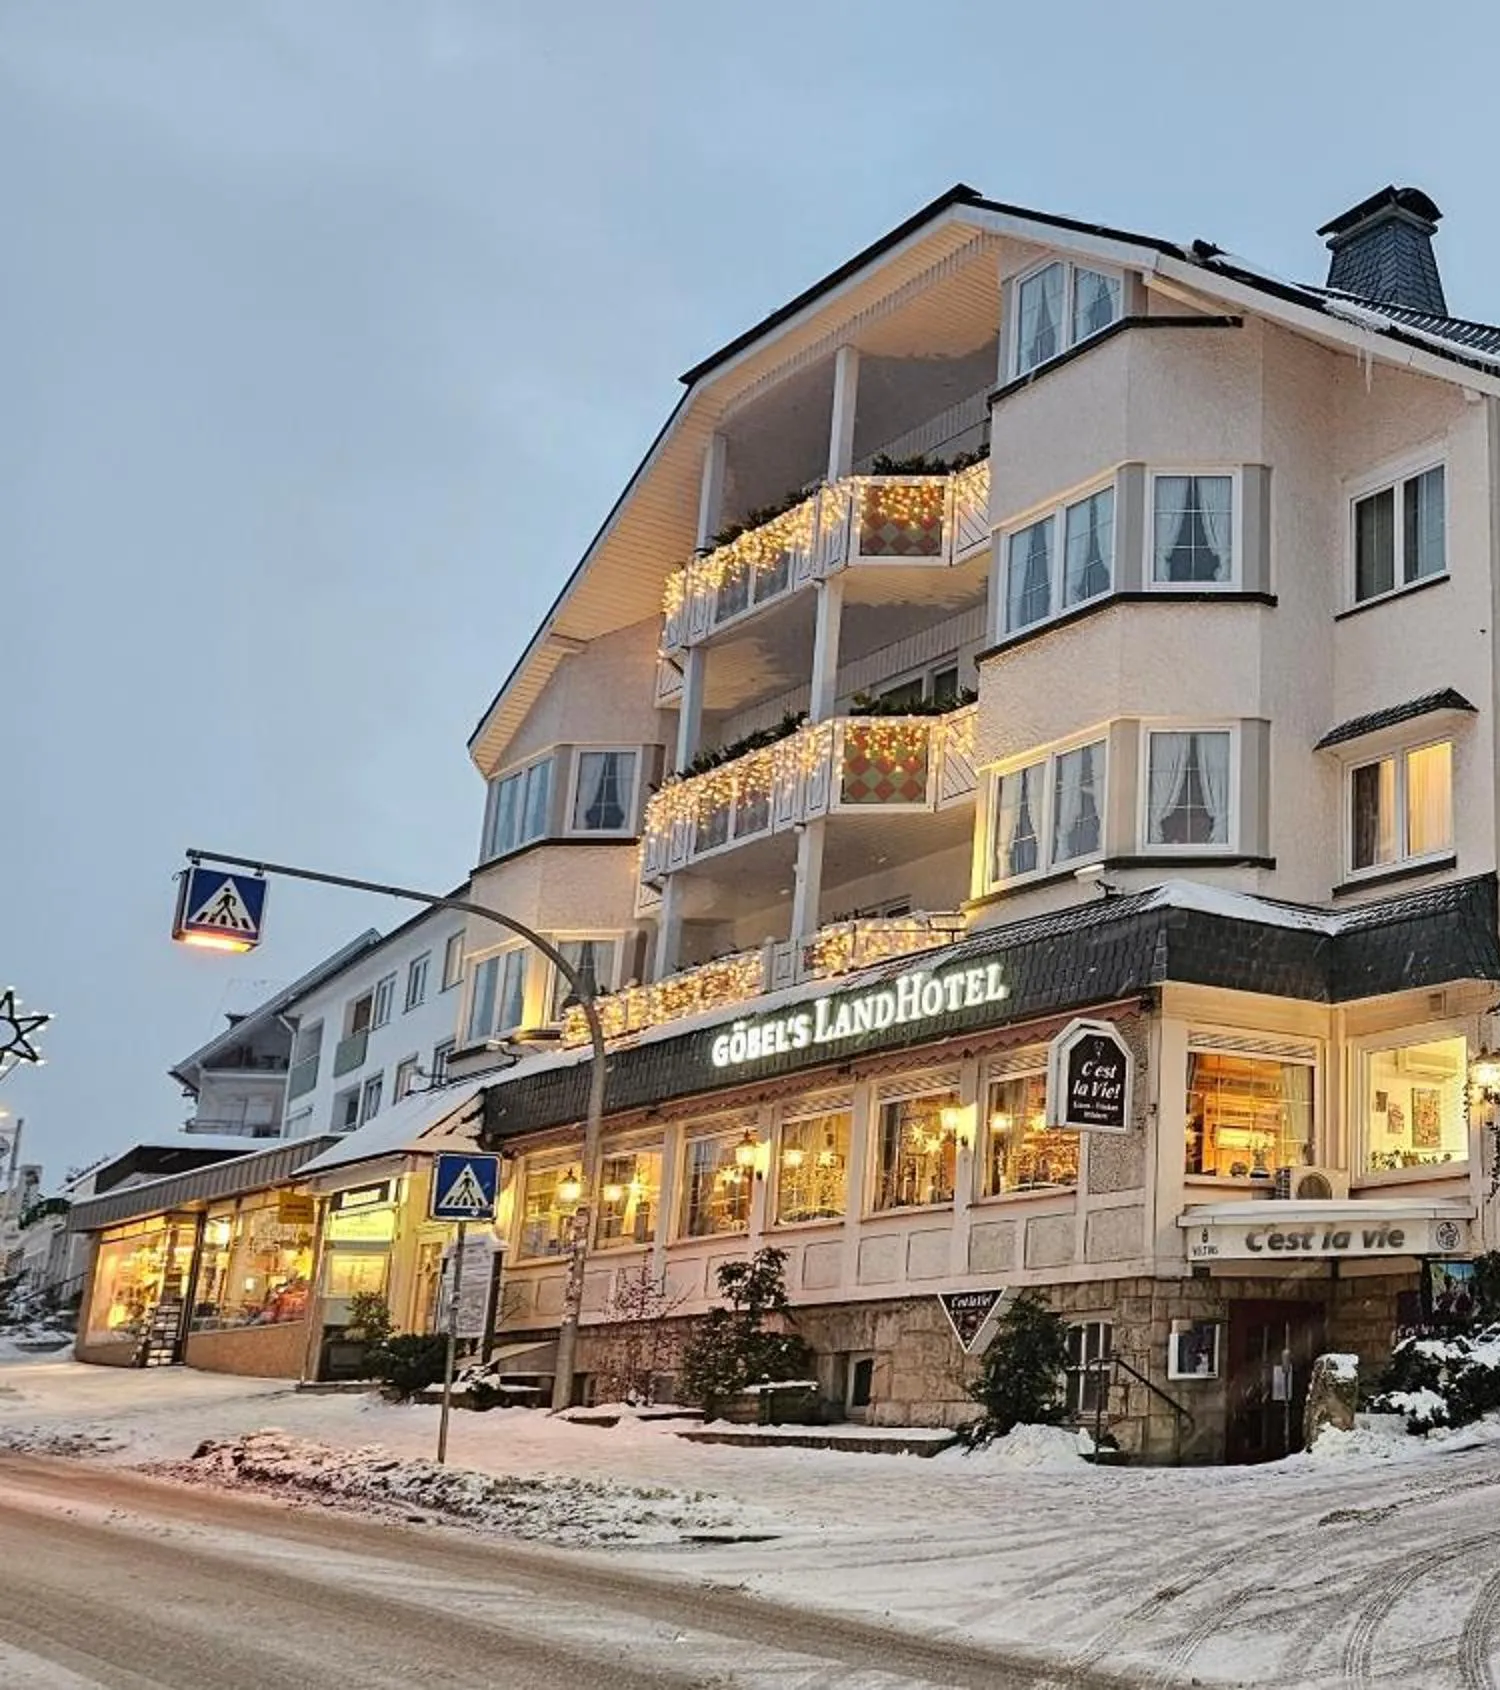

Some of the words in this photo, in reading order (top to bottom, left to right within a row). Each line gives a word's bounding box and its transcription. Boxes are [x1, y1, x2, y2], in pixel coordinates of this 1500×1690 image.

[711, 1012, 812, 1067] GÖBEL'S
[1073, 1080, 1089, 1096] la
[1091, 1081, 1121, 1099] Vie!
[1321, 1222, 1352, 1250] la
